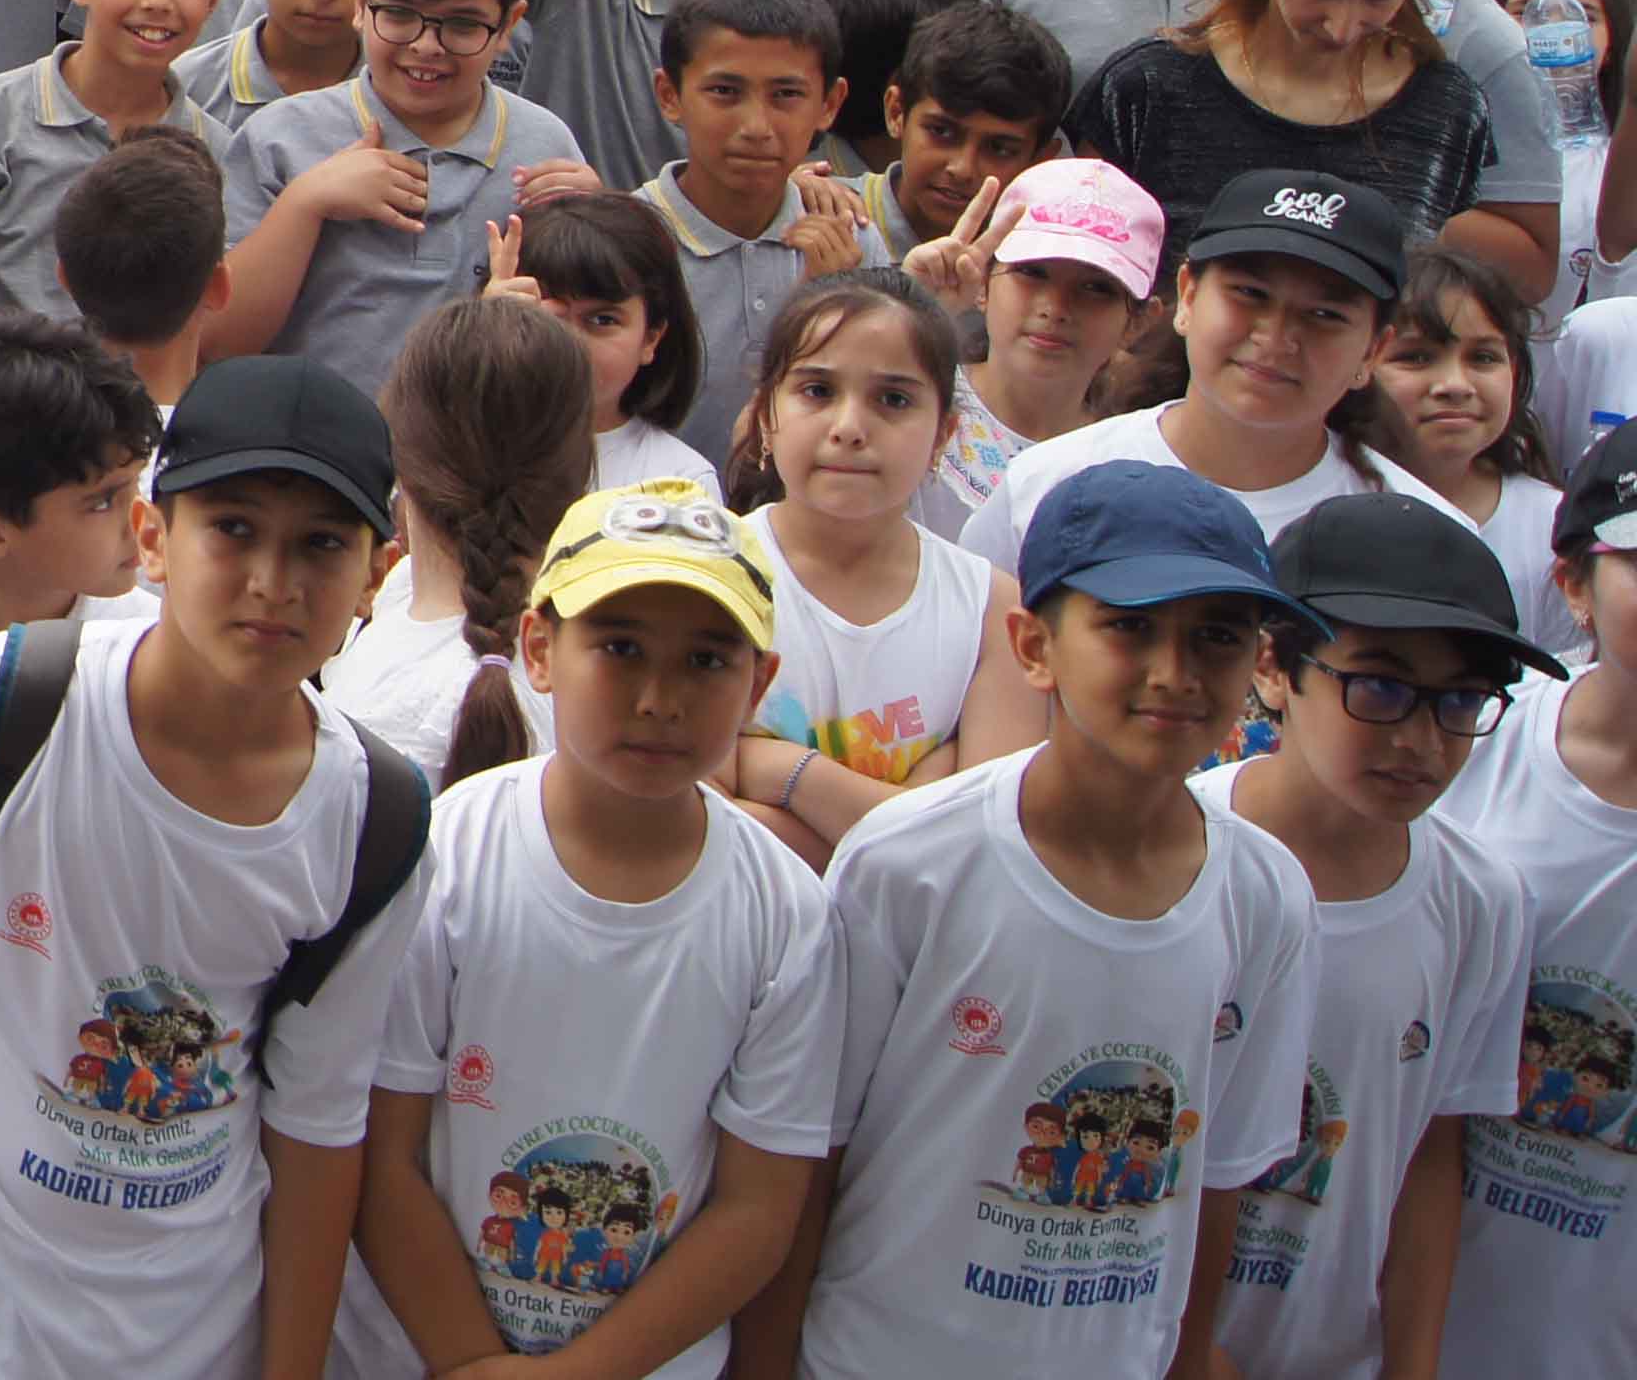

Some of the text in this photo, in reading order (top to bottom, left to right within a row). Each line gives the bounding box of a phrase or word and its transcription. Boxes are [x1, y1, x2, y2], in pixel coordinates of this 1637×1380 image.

[91, 1121, 138, 1147] Ortak
[19, 1147, 114, 1208] KADİRLİ
[977, 1200, 1036, 1236] Dünya
[1041, 1215, 1085, 1238] Ortak
[1485, 1181, 1607, 1241] BELEDİYESİ
[504, 1289, 554, 1316] Ortak
[964, 1261, 1056, 1309] KADİRLİ
